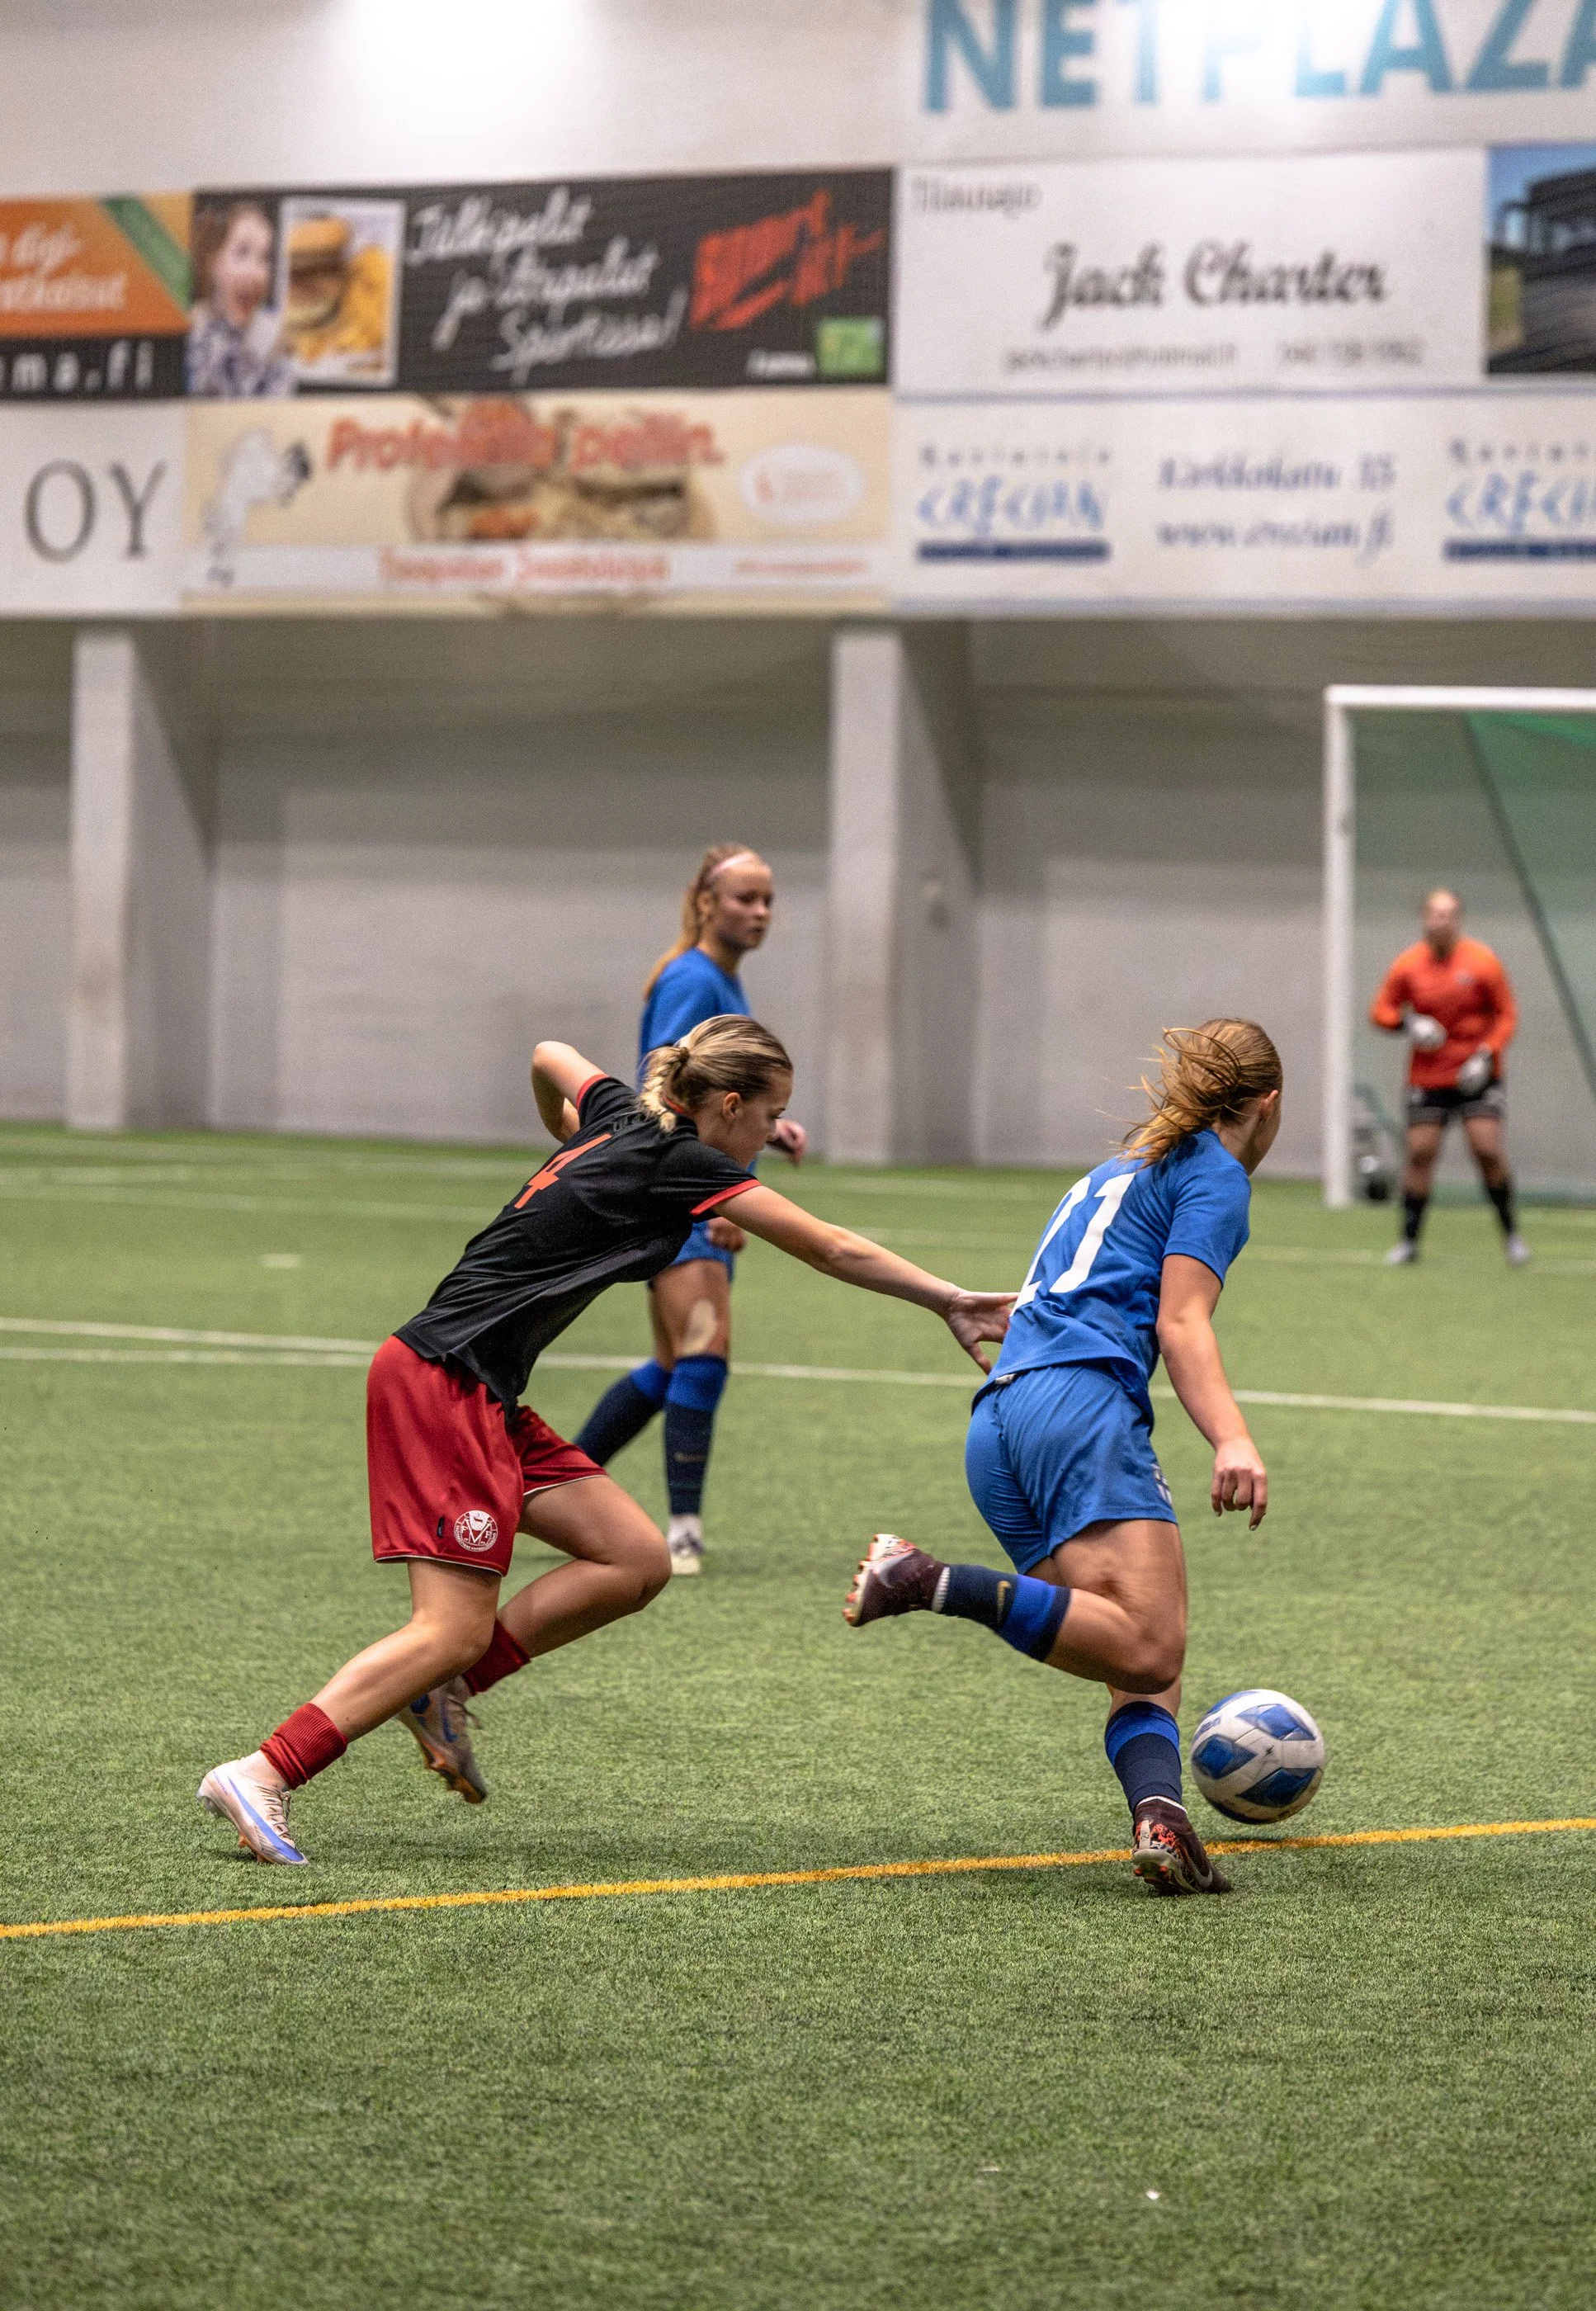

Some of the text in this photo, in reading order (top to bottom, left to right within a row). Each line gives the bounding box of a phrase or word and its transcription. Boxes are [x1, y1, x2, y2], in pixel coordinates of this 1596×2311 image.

[1040, 239, 1390, 332] Jack Charter
[0, 340, 154, 392] ma.fi
[25, 458, 169, 563] OY
[514, 1133, 612, 1209] 4
